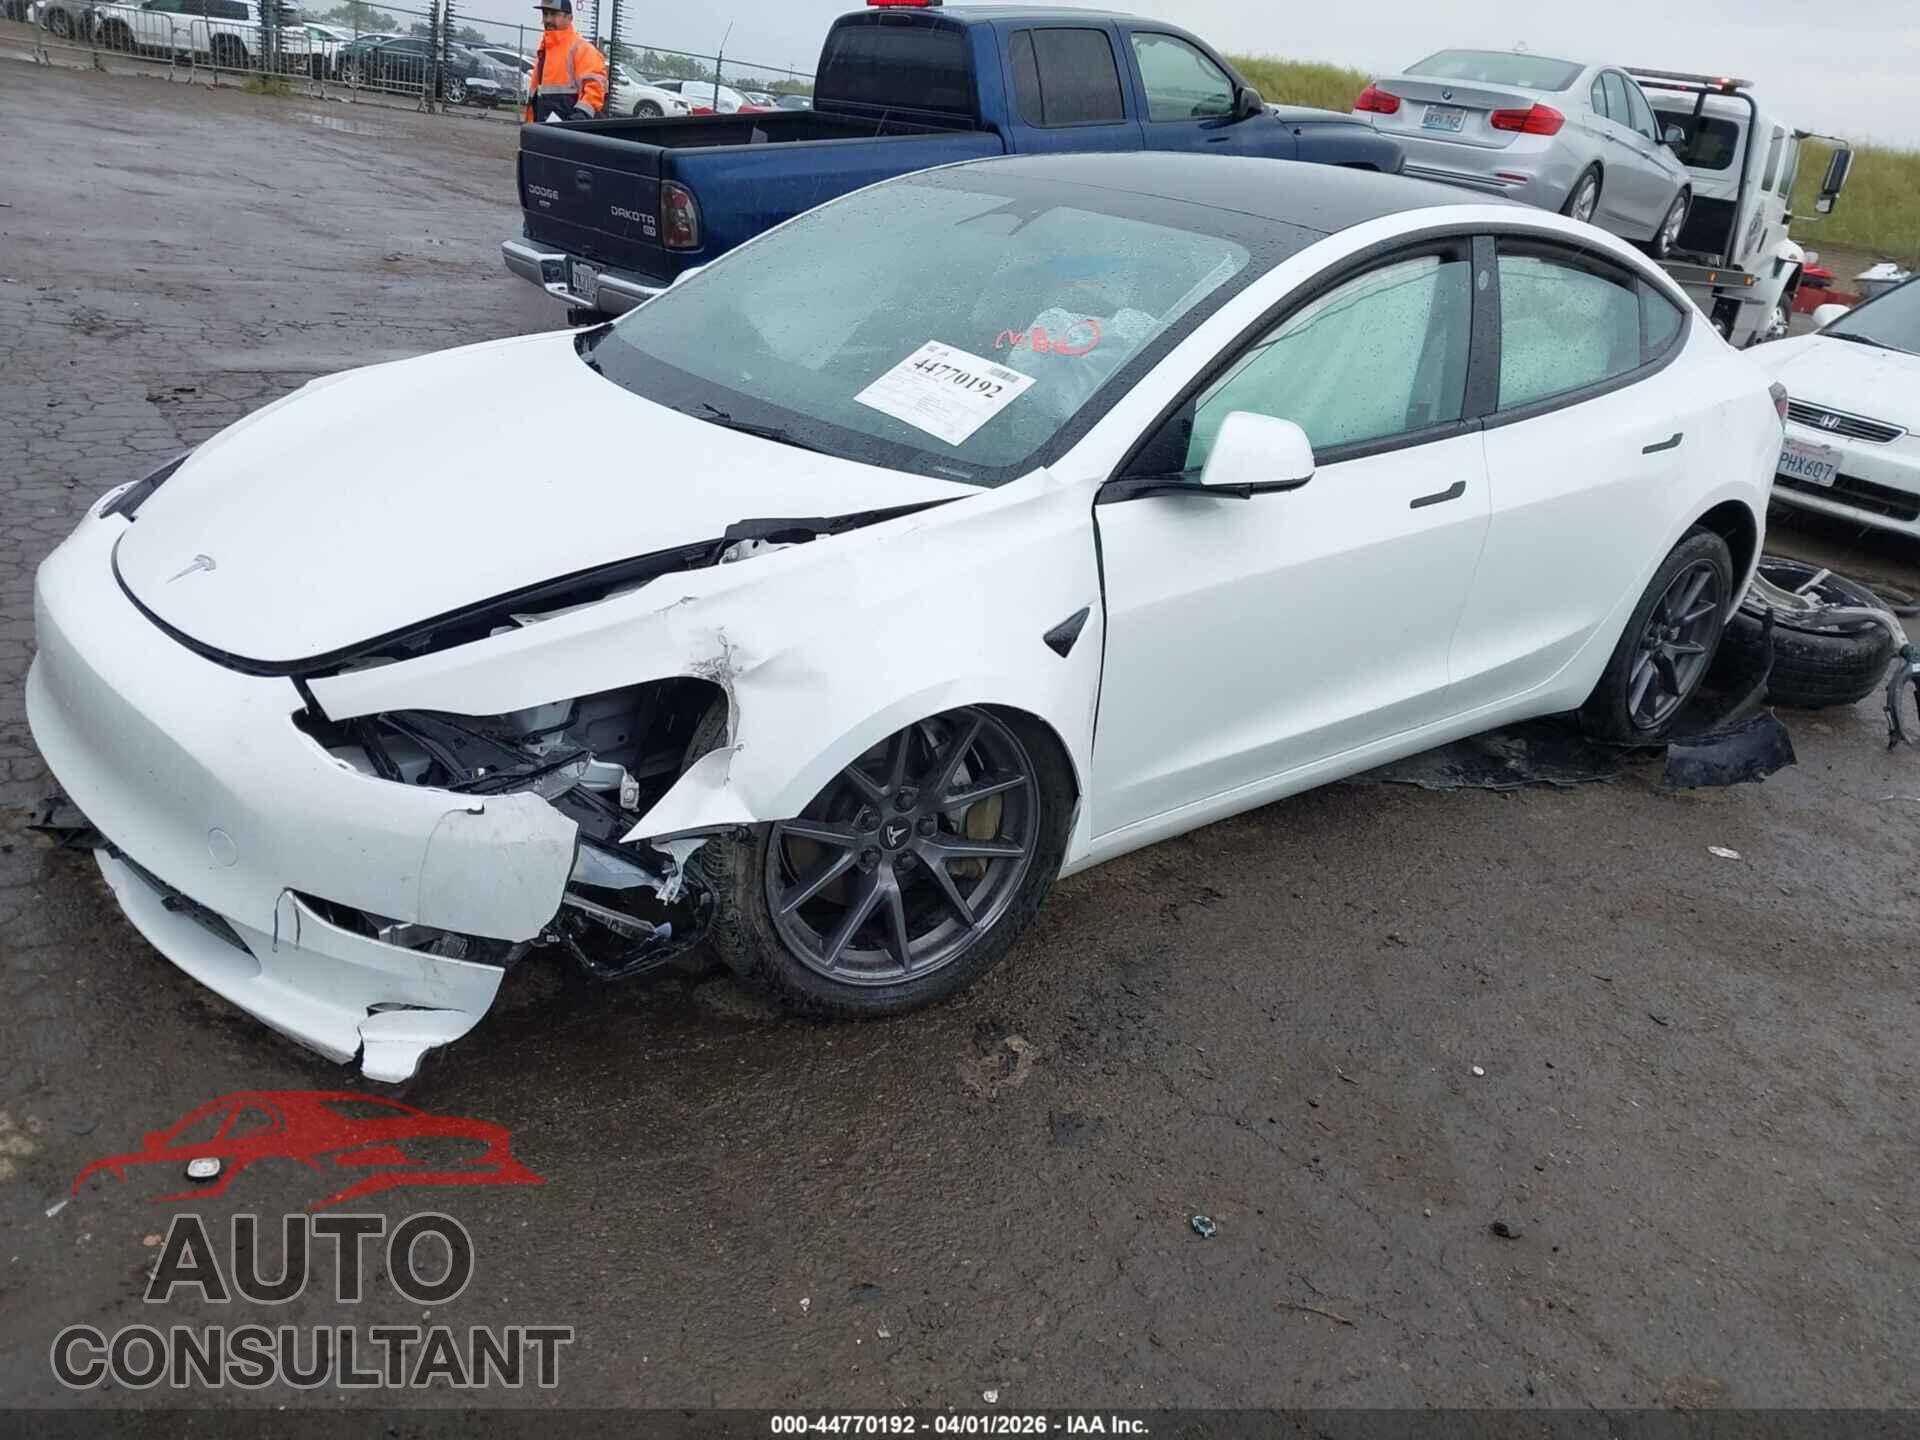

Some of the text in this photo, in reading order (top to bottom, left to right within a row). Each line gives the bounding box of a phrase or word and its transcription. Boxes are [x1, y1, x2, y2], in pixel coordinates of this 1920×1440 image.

[528, 183, 559, 200] DODGE
[610, 205, 656, 226] DAKOTA
[913, 358, 1003, 399] 44770192
